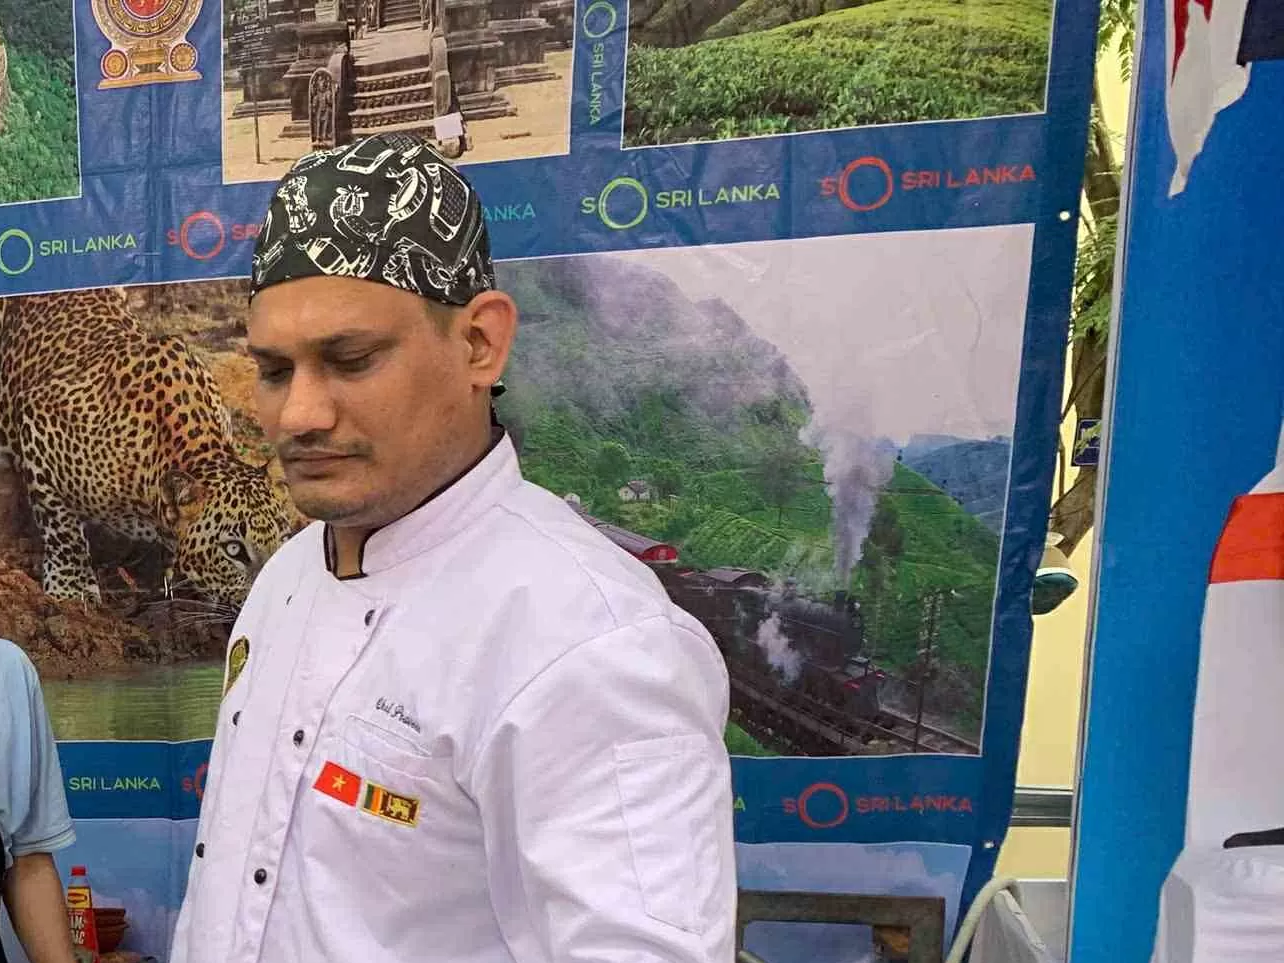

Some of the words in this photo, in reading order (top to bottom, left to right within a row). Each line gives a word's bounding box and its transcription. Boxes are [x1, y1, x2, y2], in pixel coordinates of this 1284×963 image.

[589, 71, 604, 126] LANKA
[900, 170, 940, 191] SRI
[946, 165, 1036, 188] LANKA
[656, 188, 692, 209] SRI
[698, 183, 781, 206] LANKA
[482, 202, 537, 222] ANKA
[39, 239, 68, 257] SRI
[72, 233, 138, 254] LANKA
[69, 776, 97, 791] SRI
[100, 776, 161, 791] LANKA
[856, 796, 892, 814] SRI
[892, 794, 974, 813] LANKA
